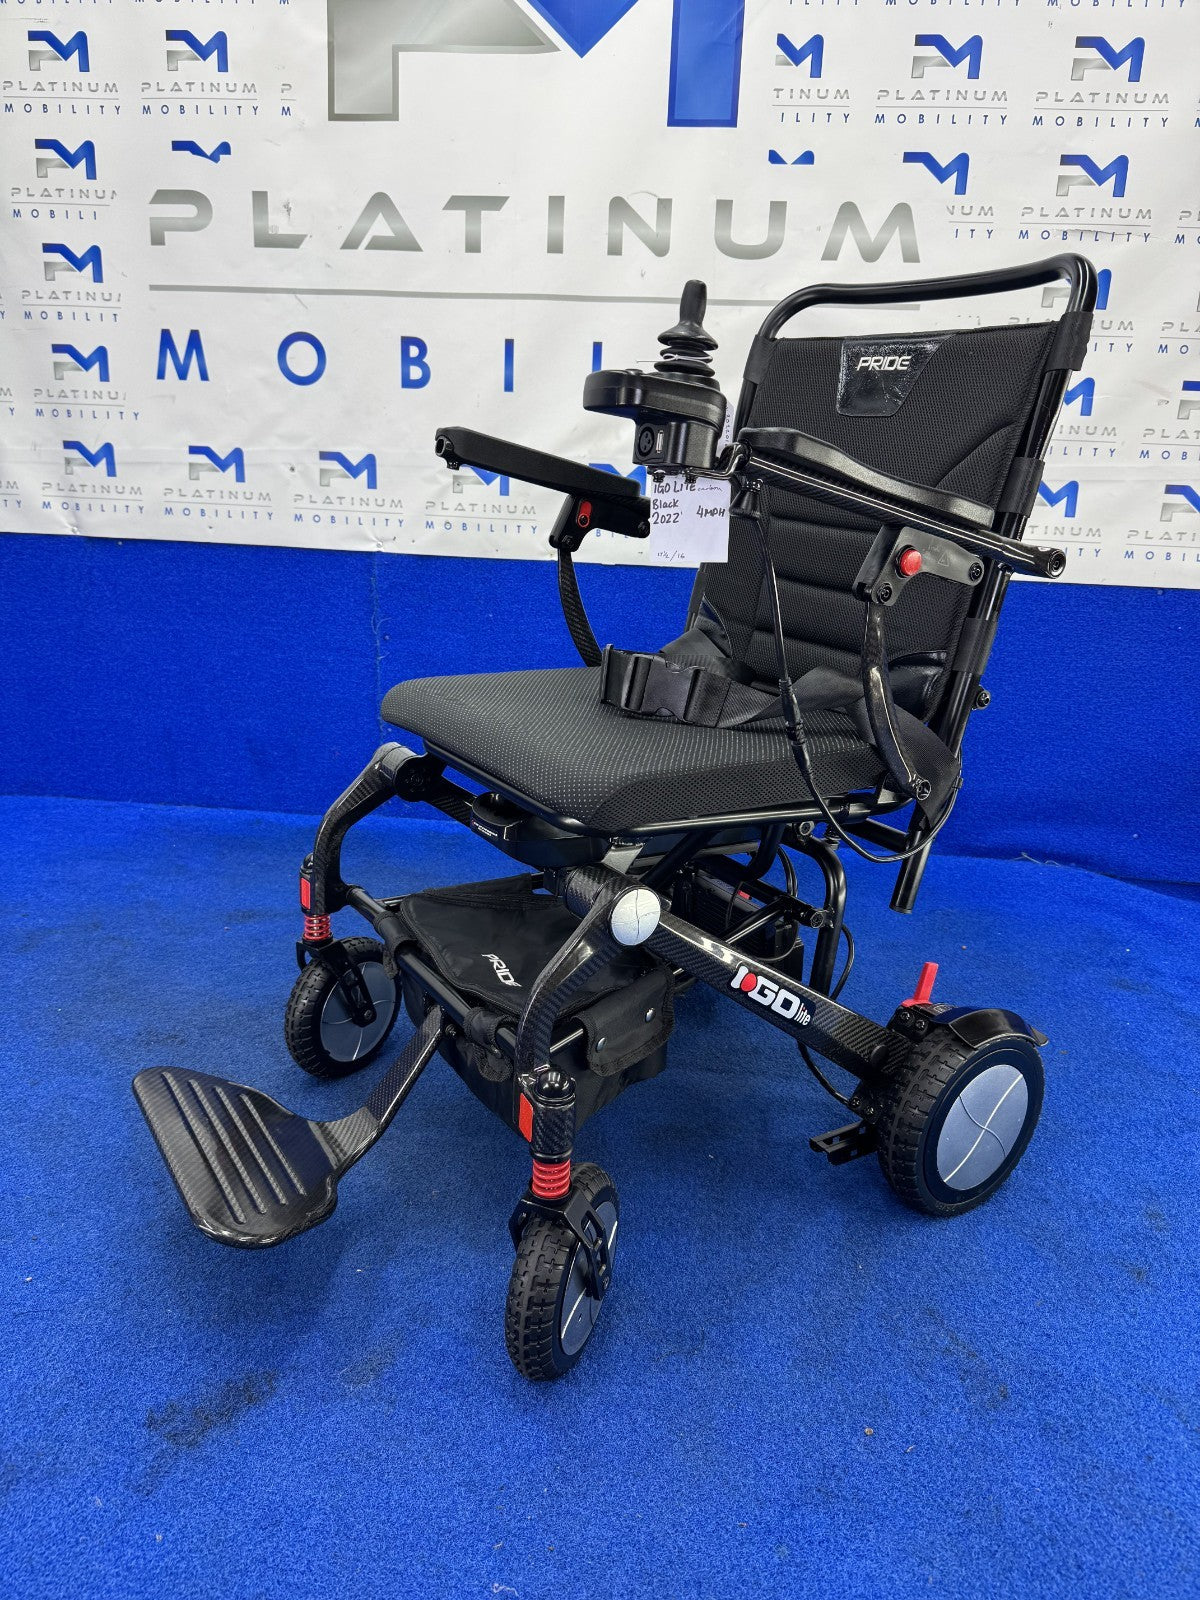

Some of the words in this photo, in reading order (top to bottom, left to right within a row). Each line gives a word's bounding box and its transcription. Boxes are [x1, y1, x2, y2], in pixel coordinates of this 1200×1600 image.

[2, 81, 119, 93] PLATINUM
[141, 82, 257, 93] PLATINUM
[773, 88, 850, 99] TINUM
[877, 90, 1008, 101] PLATINUM
[1035, 92, 1169, 104] PLATINUM
[4, 103, 121, 115] MOBILITY
[142, 105, 258, 116] MOBILITY
[781, 112, 850, 123] ILITY
[875, 114, 1007, 125] MOBILITY
[1032, 116, 1168, 128] MOBILITY
[13, 209, 97, 220] MOBILI
[1021, 207, 1151, 219] PLATINUM
[150, 188, 921, 263] PLATINUM
[955, 229, 993, 239] ITY
[1018, 229, 1150, 242] MOBILITY
[24, 311, 118, 322] MOBILIT
[1094, 343, 1133, 352] ITY
[855, 356, 912, 371] PRIDE
[36, 408, 139, 420] MOBILITY
[1059, 425, 1117, 436] INUM
[1049, 446, 1116, 457] ILITY
[42, 482, 143, 495] PLATINUM
[163, 488, 272, 501] PLATINUM
[42, 501, 144, 513] MOBILITY
[294, 494, 402, 508] PLATINUM
[652, 498, 679, 510] Black
[164, 507, 273, 520] MOBILITY
[425, 501, 537, 515] PLATINUM
[294, 514, 404, 527] MOBILITY
[425, 521, 538, 534] MOBILITY
[1028, 525, 1102, 537] TINUM
